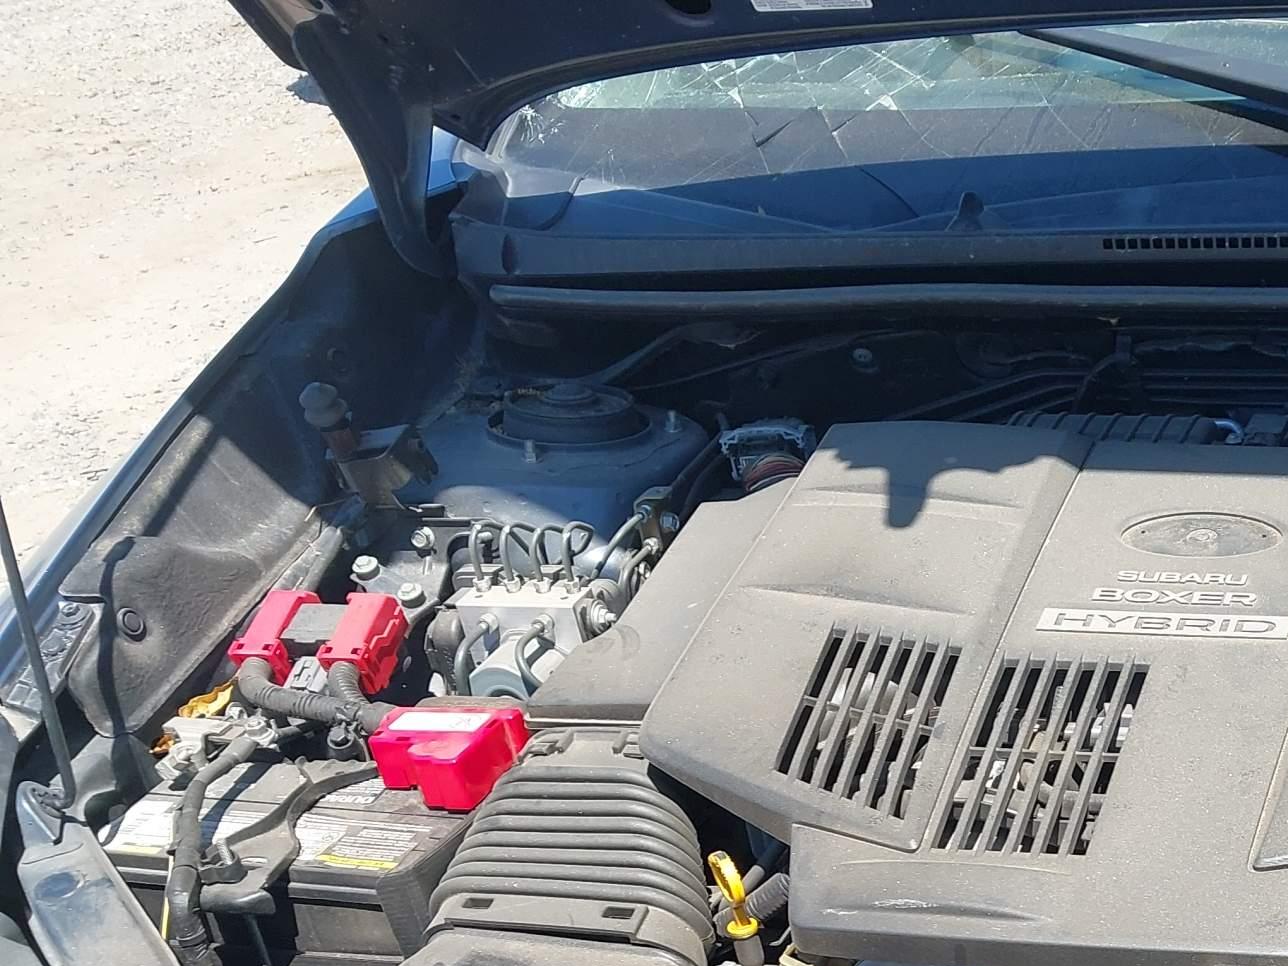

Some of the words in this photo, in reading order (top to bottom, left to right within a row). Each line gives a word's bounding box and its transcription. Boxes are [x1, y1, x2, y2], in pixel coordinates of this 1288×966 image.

[1117, 570, 1248, 585] SUBARU
[1091, 587, 1257, 607] BOXER
[1053, 612, 1277, 634] HYBRID
